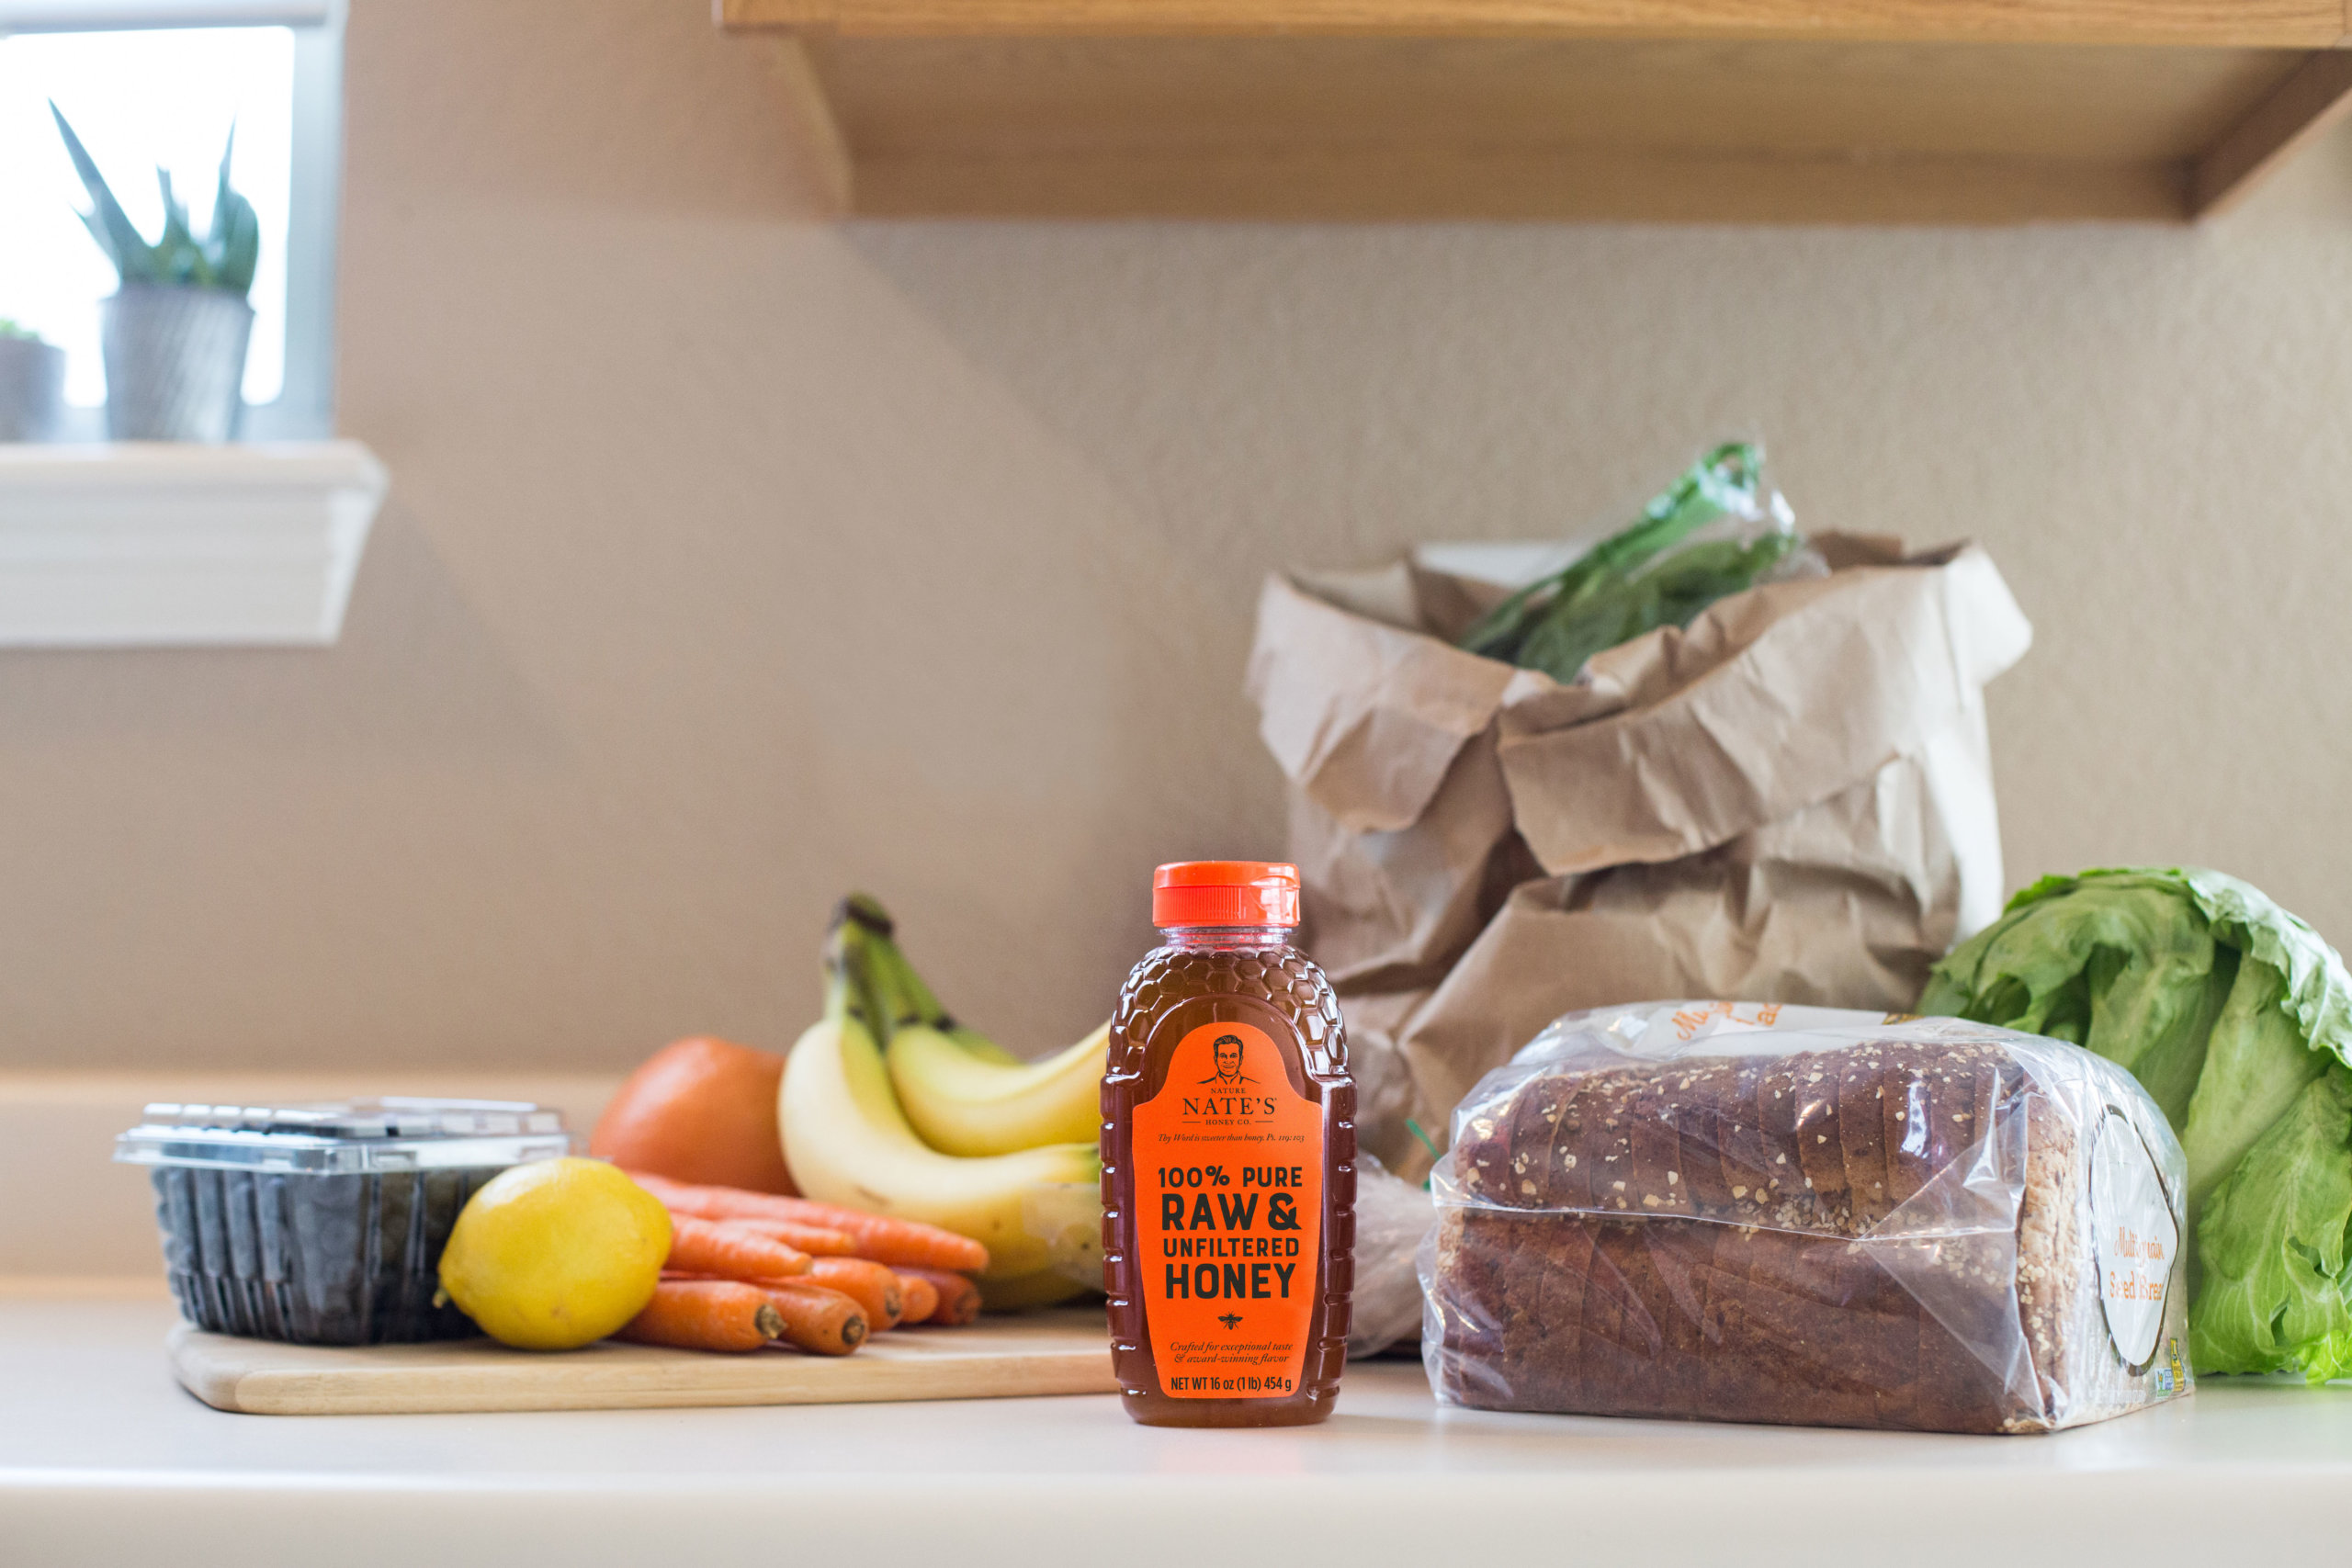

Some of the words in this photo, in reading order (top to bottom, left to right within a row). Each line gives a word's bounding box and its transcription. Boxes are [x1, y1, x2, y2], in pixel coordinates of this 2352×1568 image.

[1159, 1134, 1171, 1145] Thy
[1173, 1134, 1194, 1142] Word
[1194, 1134, 1200, 1142] is
[1227, 1134, 1243, 1142] than
[1244, 1134, 1264, 1145] honey.
[1266, 1133, 1276, 1142] Ps.
[1158, 1165, 1230, 1188] 100%
[1242, 1166, 1303, 1188] PURE
[1161, 1192, 1260, 1231] RAW
[1268, 1192, 1302, 1231] &
[1163, 1237, 1299, 1258] UNFILTERED
[1165, 1262, 1296, 1300] HONEY
[1170, 1341, 1204, 1353] Crafted
[1203, 1341, 1220, 1353] for
[1220, 1341, 1272, 1354] exceptional
[1272, 1342, 1294, 1351] taste
[1174, 1353, 1185, 1363] &
[1186, 1353, 1258, 1366] award-winning
[1258, 1353, 1290, 1366] flavor
[1170, 1377, 1190, 1391] NET
[1192, 1377, 1208, 1391] WT
[1210, 1377, 1221, 1391] 16
[1223, 1380, 1235, 1391] oz
[1248, 1377, 1262, 1392] lb)
[1263, 1377, 1283, 1391] 454
[1284, 1380, 1292, 1392] g
